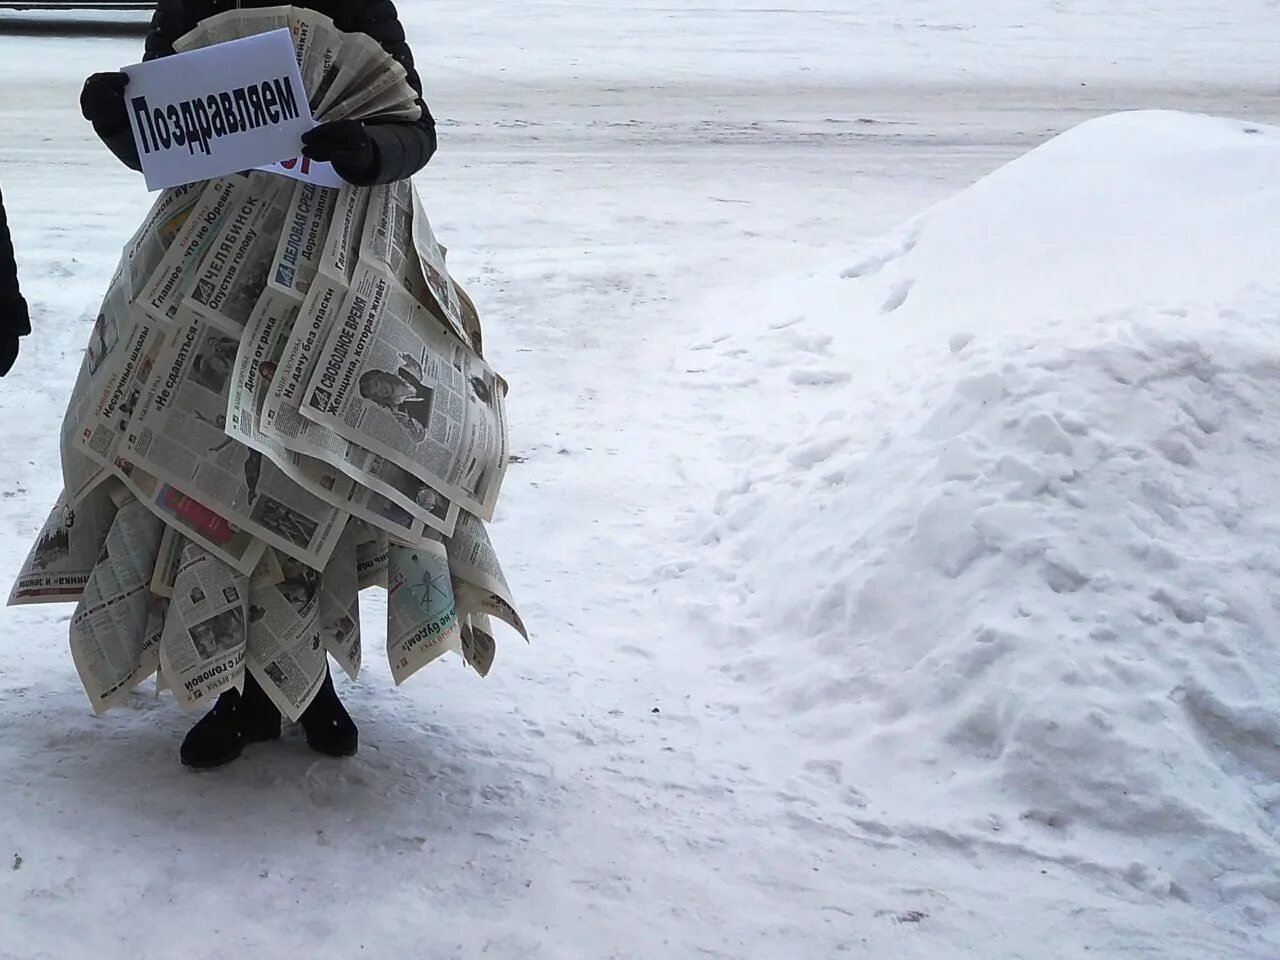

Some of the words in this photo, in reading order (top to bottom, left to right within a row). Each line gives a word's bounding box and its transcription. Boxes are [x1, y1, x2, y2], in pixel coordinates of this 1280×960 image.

[131, 75, 300, 155] Поздравляем
[151, 265, 183, 309] Главное
[184, 240, 199, 258] что
[196, 225, 209, 240] не
[204, 182, 235, 225] Юревич
[205, 196, 259, 280] ЧЕЛЯБИНСК
[209, 266, 237, 310] Опустив
[233, 227, 257, 264] голову
[284, 215, 307, 266] ДЕЛОВАЯ
[302, 223, 319, 261] Дорого
[102, 362, 134, 419] Нескучные
[130, 326, 150, 362] школы
[169, 326, 198, 389] сдаваться
[245, 357, 259, 393] Диета
[255, 346, 264, 358] от
[261, 316, 277, 345] рака
[283, 381, 296, 399] На
[292, 353, 309, 382] дачу
[302, 331, 316, 352] без
[315, 288, 335, 330] опаски
[321, 329, 355, 389] СВОБОДНОЕ
[345, 295, 368, 331] ВРЕМЯ
[327, 359, 360, 416] Женщина,
[354, 312, 376, 358] которая
[371, 278, 387, 313] живёт
[440, 614, 451, 626] не
[184, 664, 228, 692] головой
[229, 660, 235, 668] с
